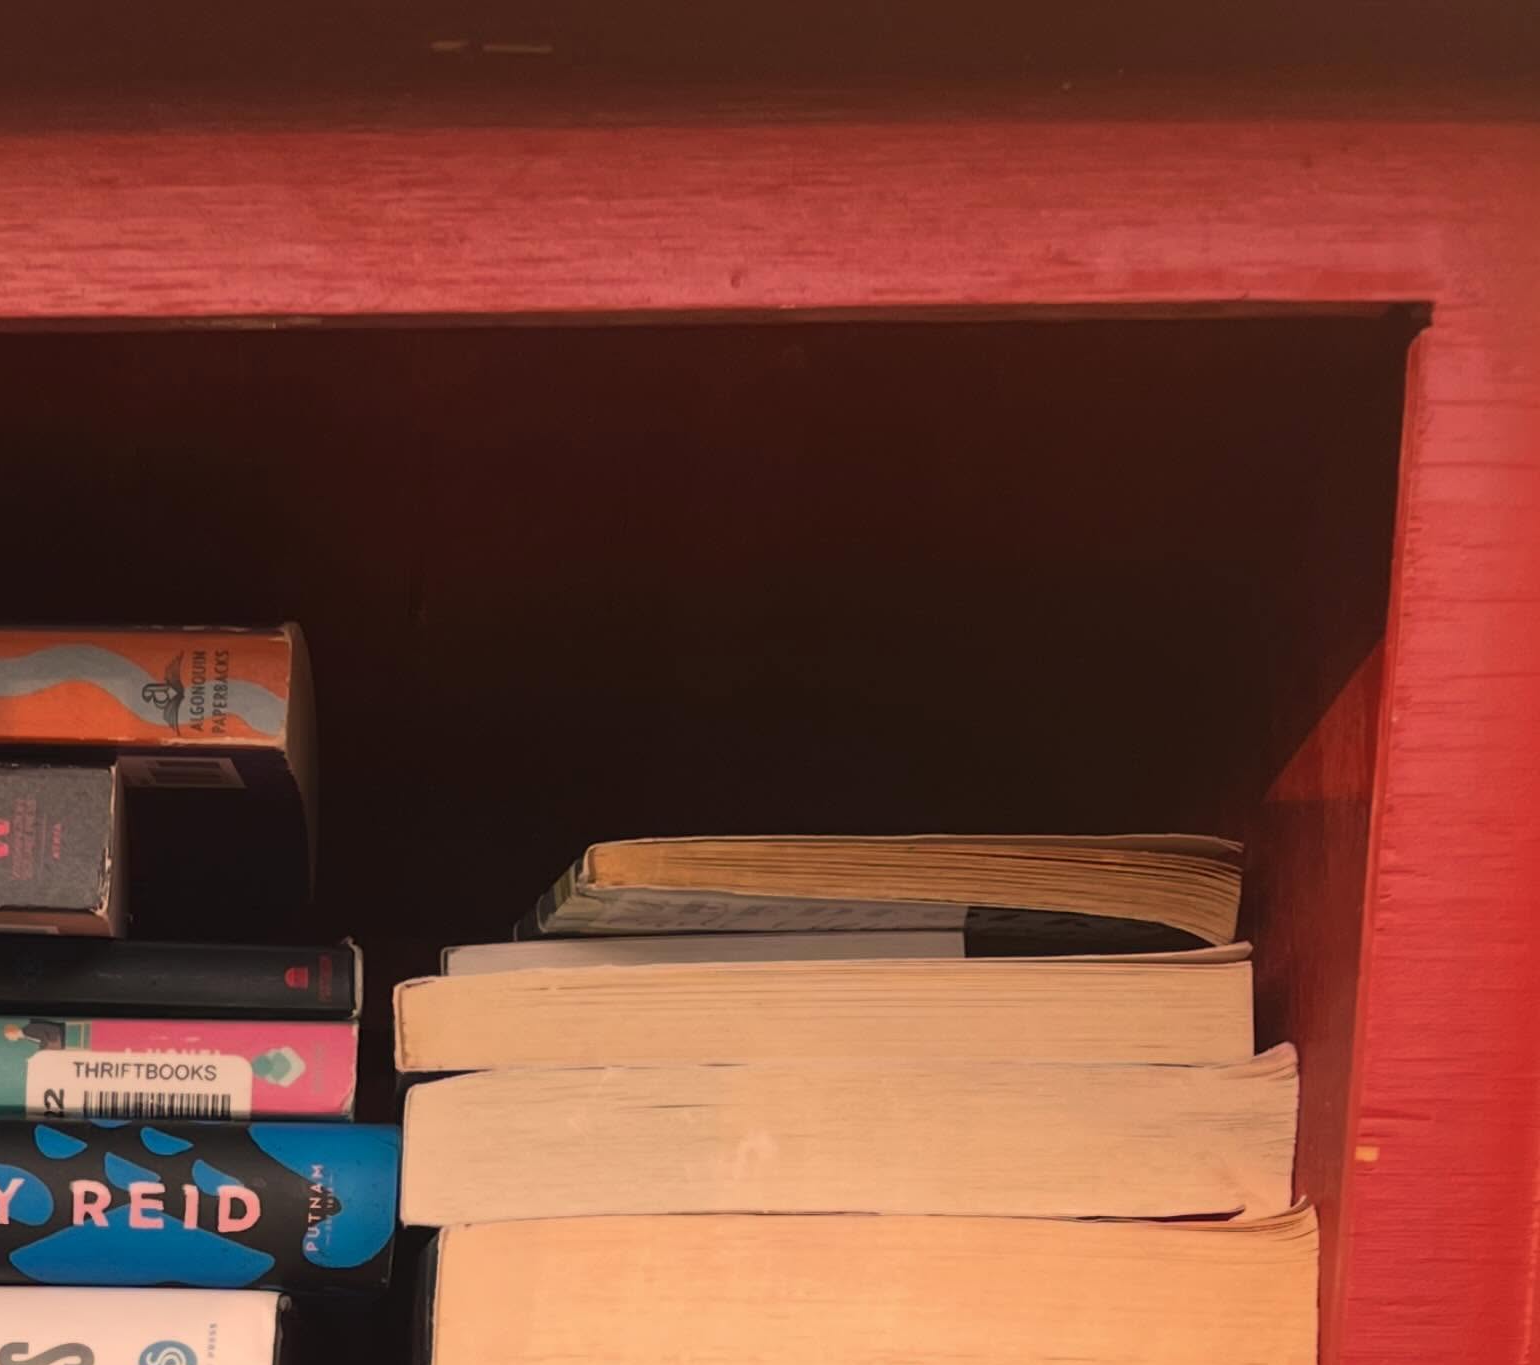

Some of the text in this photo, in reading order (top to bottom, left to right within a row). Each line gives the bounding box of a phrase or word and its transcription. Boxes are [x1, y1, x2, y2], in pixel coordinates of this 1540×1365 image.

[212, 650, 229, 733] PAPERBACKS
[73, 1062, 217, 1081] THRIFTBOOKS
[72, 1179, 260, 1234] REID
[305, 1164, 325, 1252] PUTNAM
